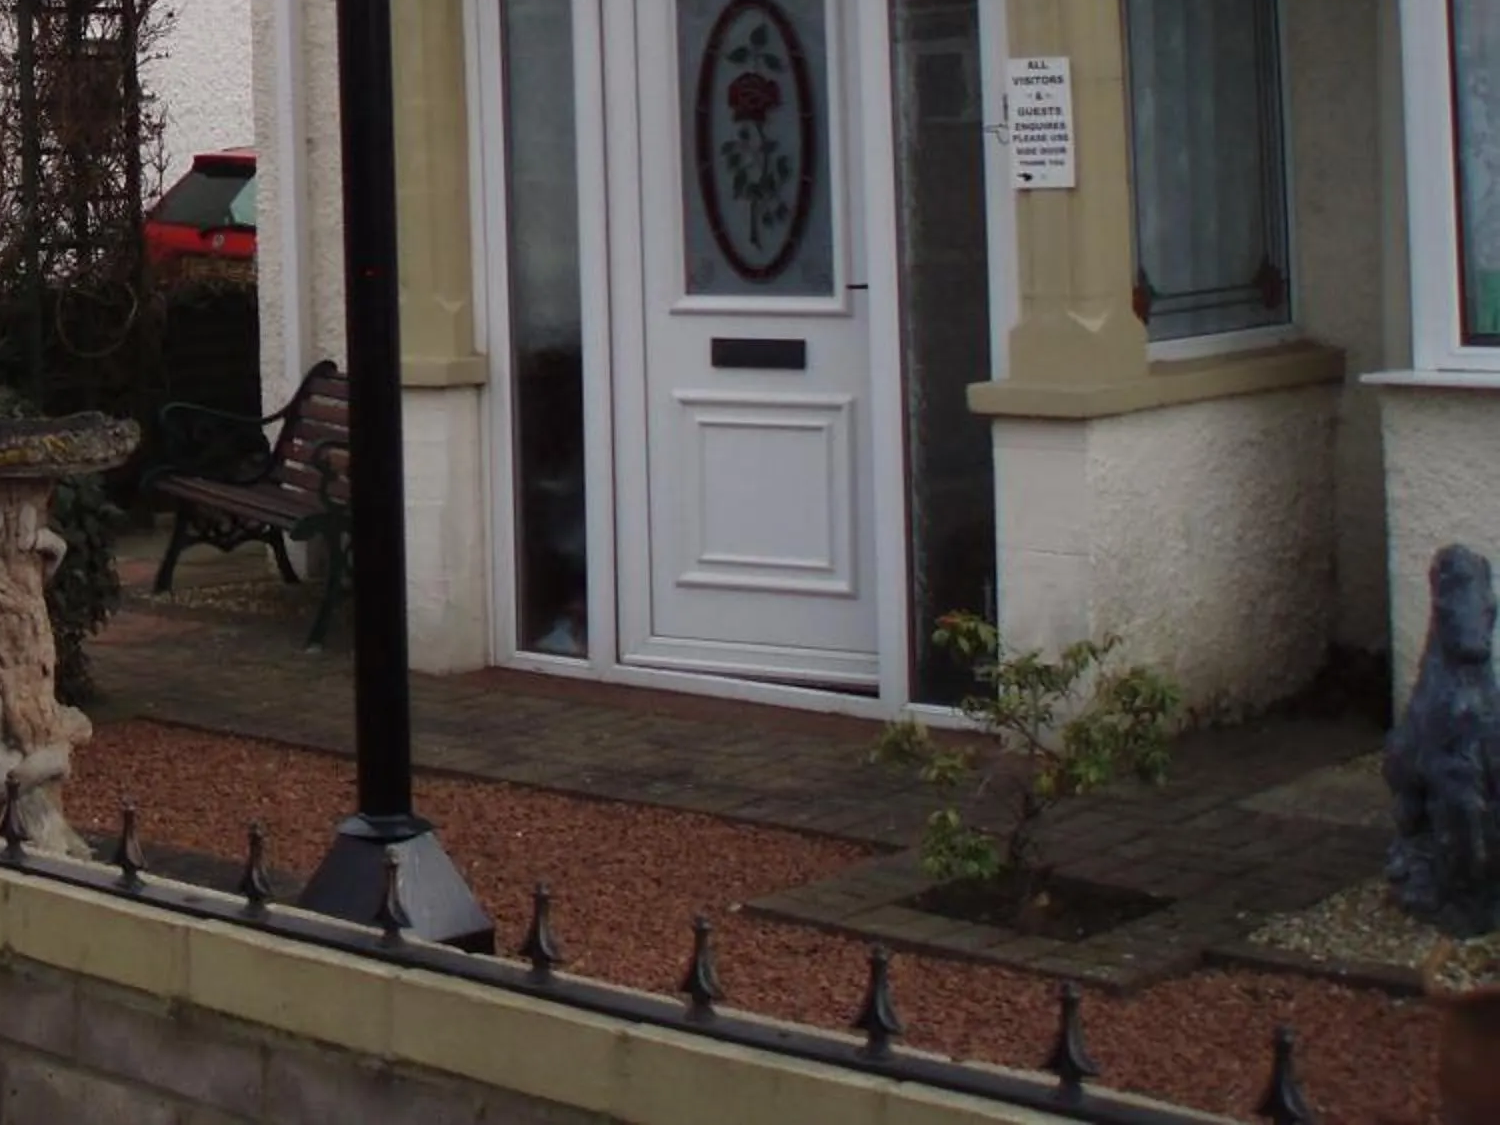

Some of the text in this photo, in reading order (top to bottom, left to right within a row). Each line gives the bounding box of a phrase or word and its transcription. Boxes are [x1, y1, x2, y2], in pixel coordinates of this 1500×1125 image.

[1027, 60, 1048, 70] ALL
[1012, 75, 1064, 86] VISITORS
[1017, 106, 1062, 116] GUESTS
[1012, 134, 1046, 142] PLEASE
